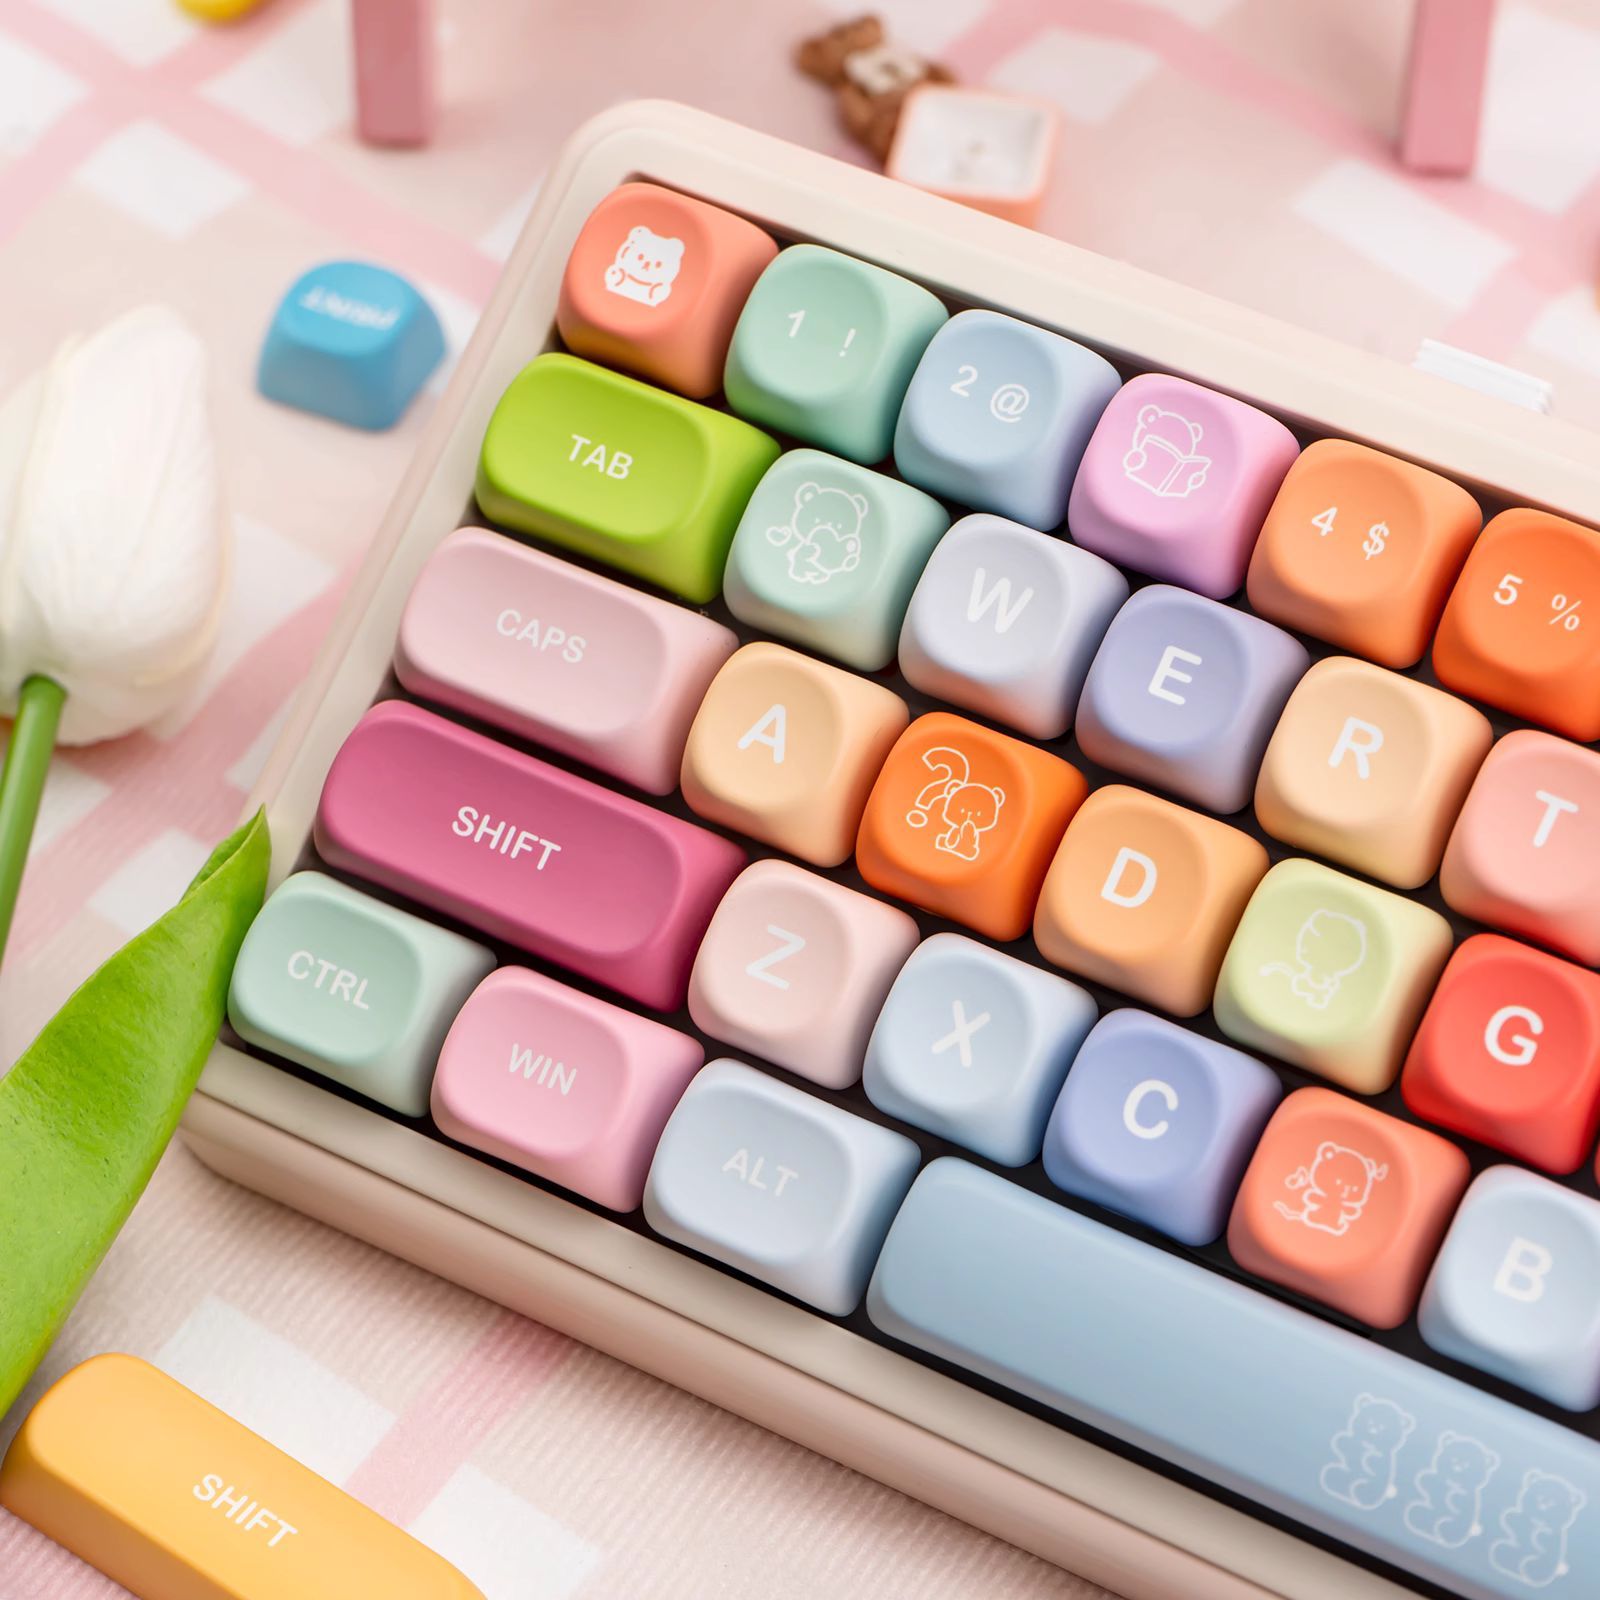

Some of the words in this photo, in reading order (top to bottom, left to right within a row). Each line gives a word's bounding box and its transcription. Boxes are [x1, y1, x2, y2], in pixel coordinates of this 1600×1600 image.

[788, 309, 806, 338] 1
[839, 327, 857, 357] !
[950, 365, 977, 397] 2
[990, 384, 1029, 423] @
[570, 435, 633, 479] TAB
[1312, 507, 1337, 536] 4
[1363, 522, 1389, 560] $
[968, 568, 1034, 633] W
[1494, 575, 1523, 605] 5
[1550, 594, 1581, 631] %
[497, 609, 586, 662] CAPS
[1148, 646, 1202, 705] E
[738, 704, 786, 763] A
[1328, 717, 1384, 779] R
[452, 806, 561, 870] SHIFT
[1534, 791, 1578, 847] T
[1101, 848, 1157, 908] D
[287, 950, 370, 1010] CTRL
[746, 925, 805, 990] Z
[932, 1000, 991, 1068] X
[1484, 1006, 1543, 1066] G
[509, 1044, 577, 1096] WIN
[1123, 1080, 1178, 1139] C
[722, 1149, 798, 1197] ALT
[1494, 1237, 1552, 1302] B
[192, 1473, 299, 1548] SHIFT
